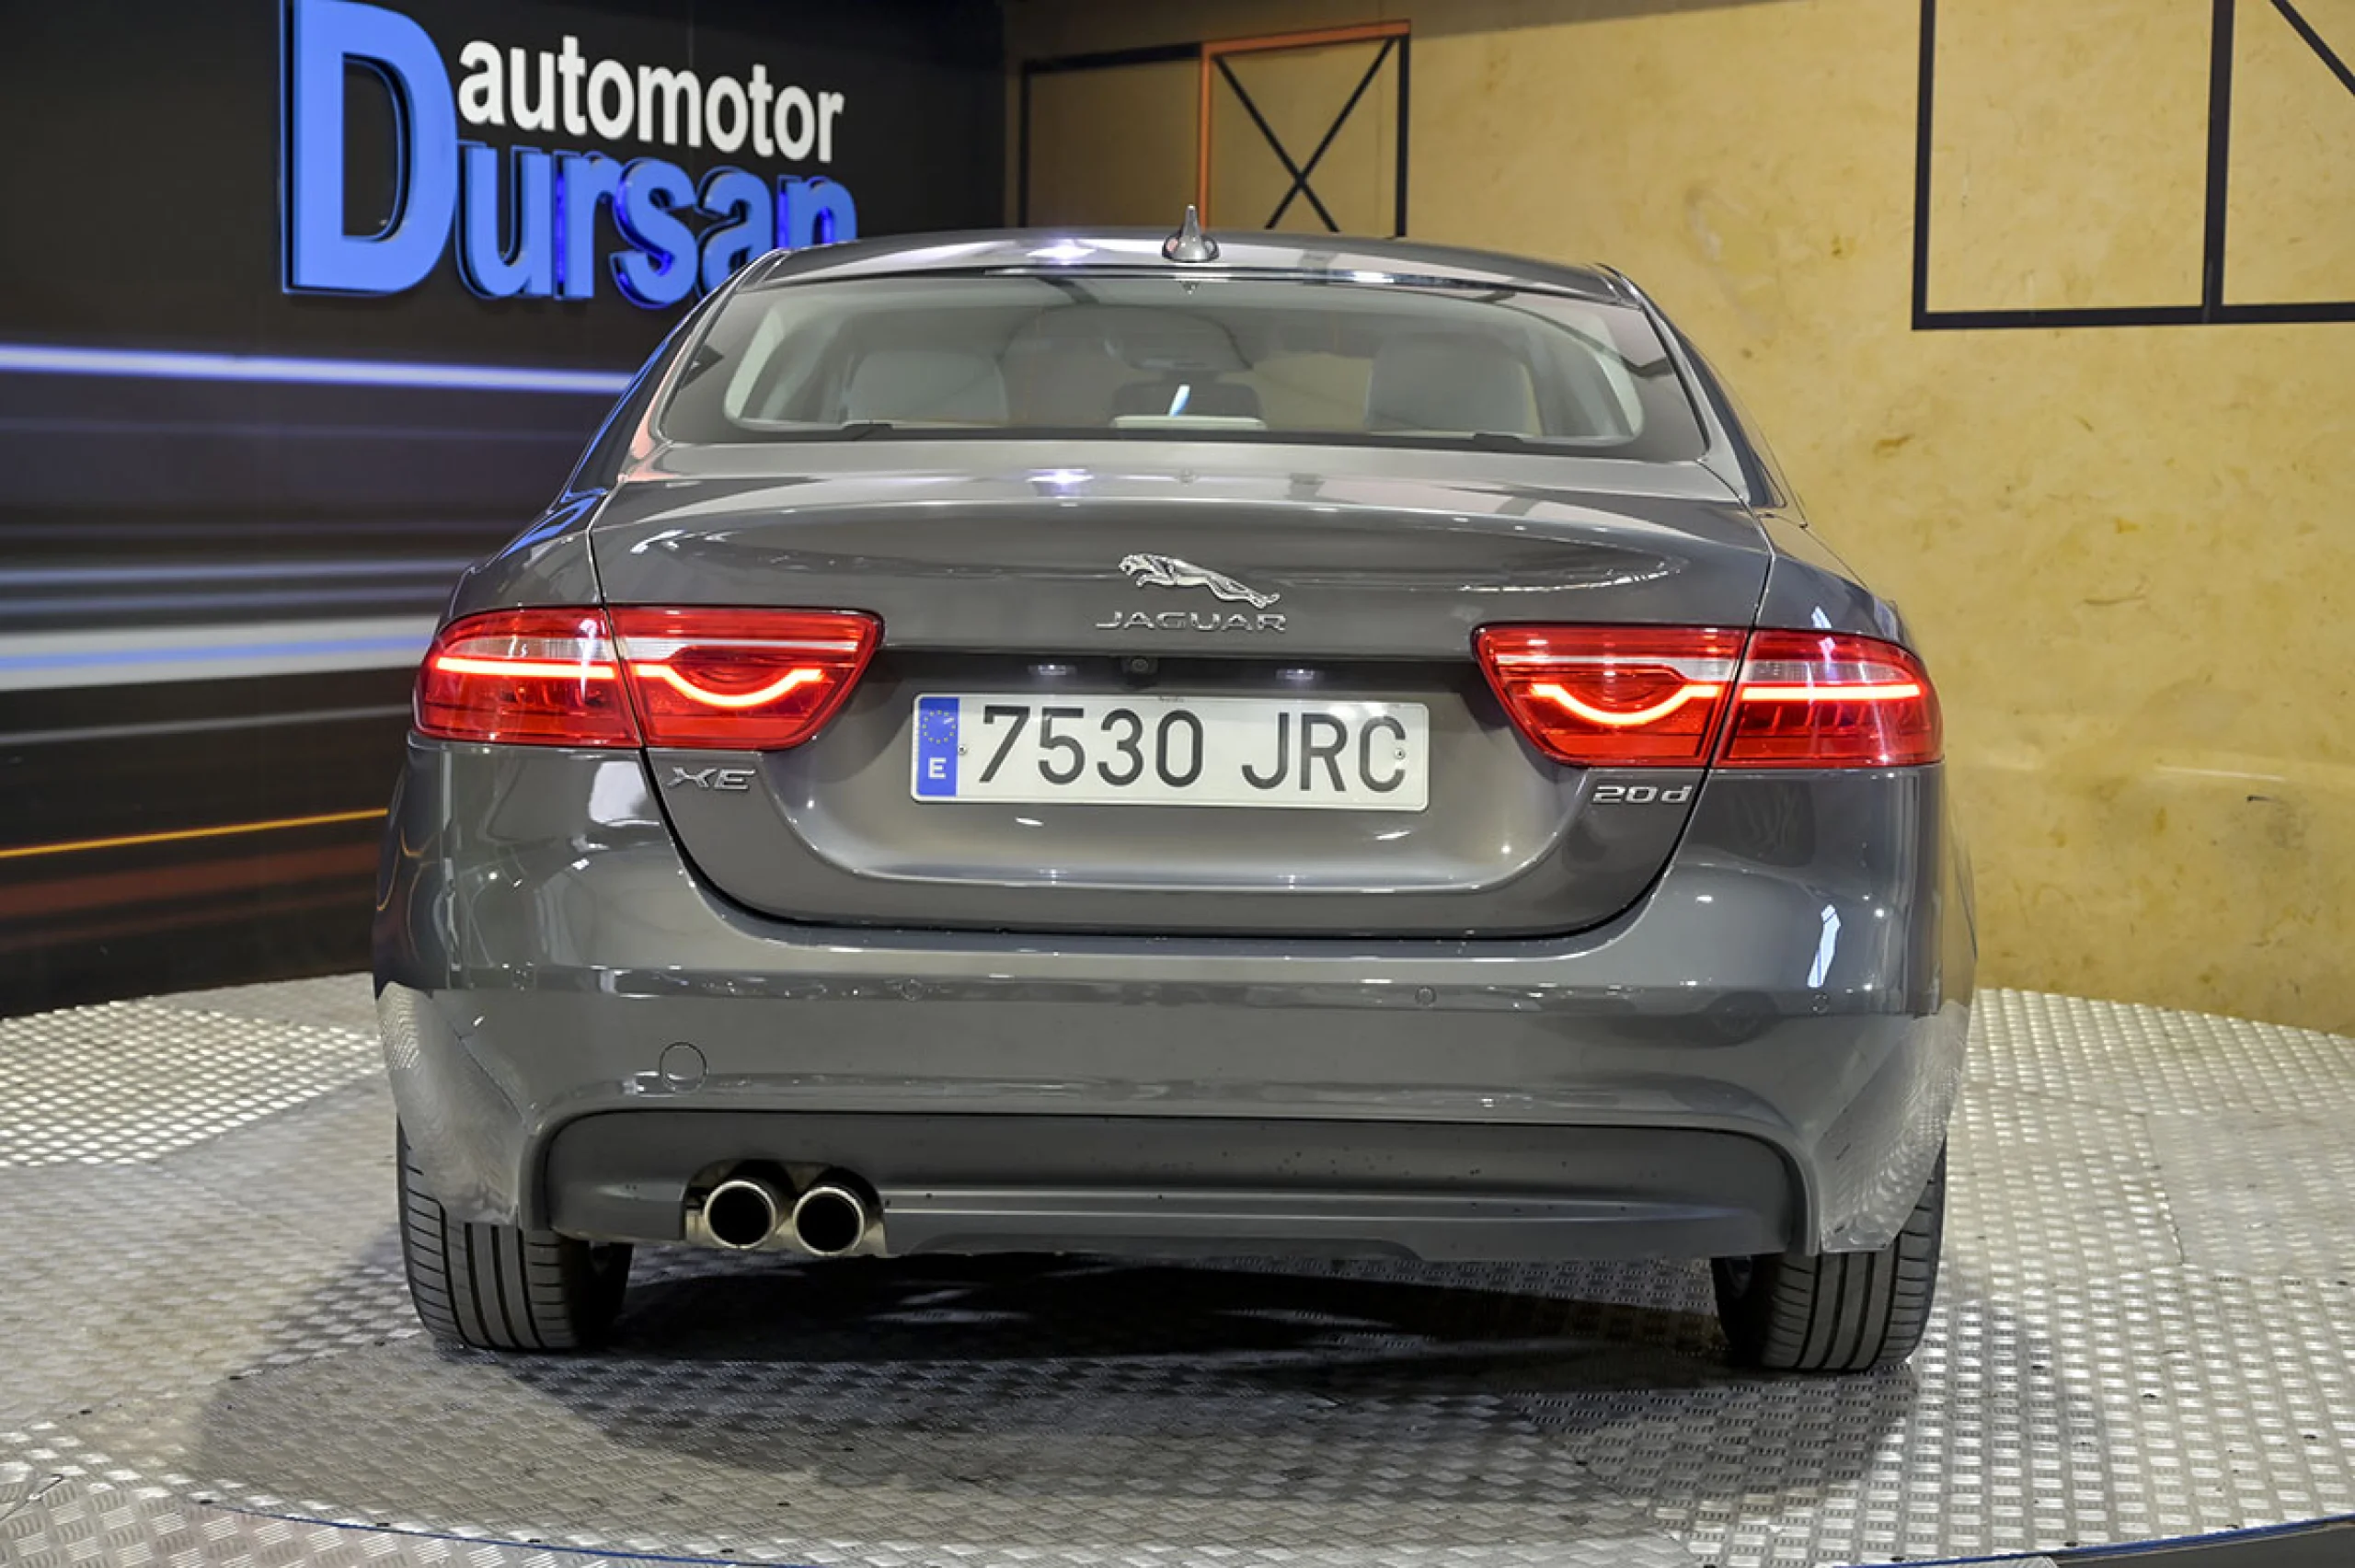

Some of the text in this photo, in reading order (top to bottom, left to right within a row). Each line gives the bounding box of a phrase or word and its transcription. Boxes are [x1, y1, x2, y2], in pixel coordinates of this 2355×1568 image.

[459, 34, 844, 164] automotor
[281, 0, 858, 309] Dursan
[1096, 611, 1287, 633] JAGUAR
[978, 704, 1407, 794] 7530 JRC
[667, 766, 756, 791] XE
[927, 757, 947, 780] E
[1592, 784, 1694, 805] 20d
